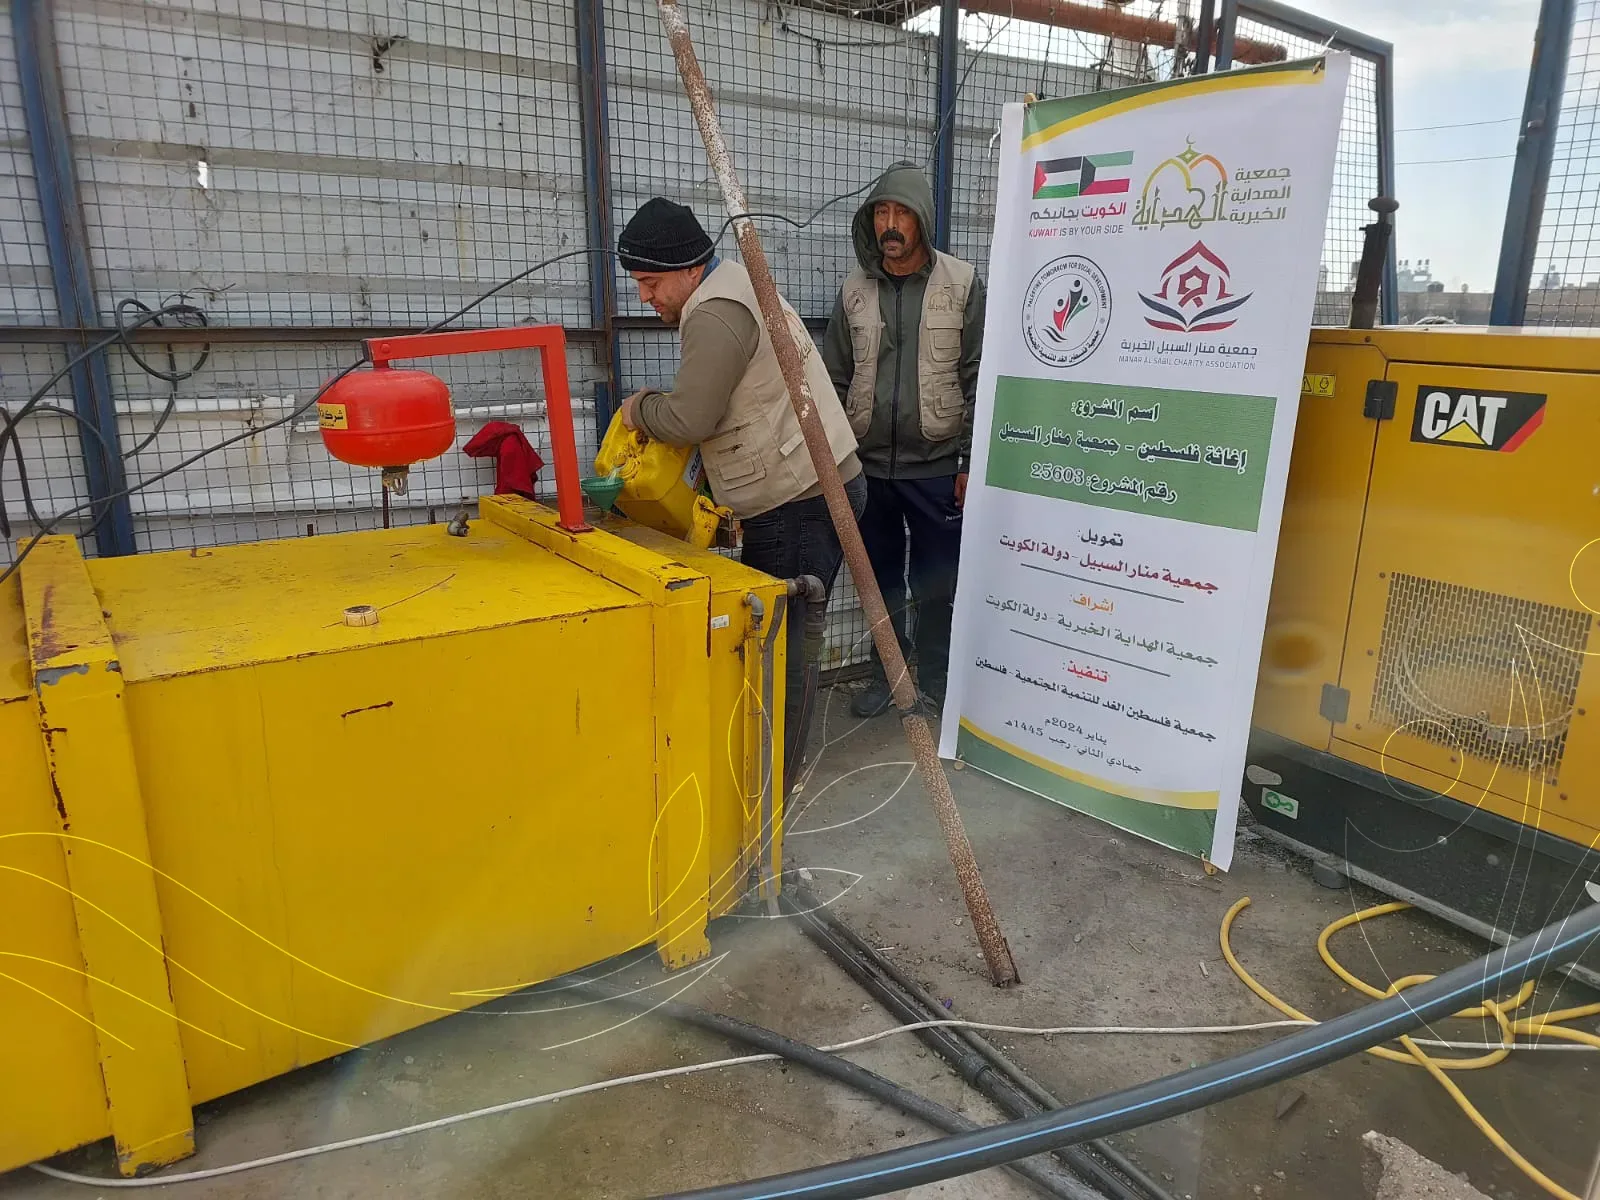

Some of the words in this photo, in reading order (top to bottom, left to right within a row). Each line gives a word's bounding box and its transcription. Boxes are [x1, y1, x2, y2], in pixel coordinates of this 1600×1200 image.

[1235, 167, 1291, 183] جمعية
[1231, 185, 1291, 204] الهداية
[1030, 206, 1079, 223] بجانبكم
[1081, 202, 1127, 219] الكويت
[1229, 206, 1287, 224] الخيرية
[1029, 228, 1058, 237] KUWAIT
[1060, 228, 1067, 236] IS
[1069, 227, 1079, 236] BY
[1080, 225, 1102, 235] YOUR
[1104, 224, 1124, 234] SIDE
[1121, 339, 1155, 352] الخيرية
[1157, 340, 1191, 354] السبيل
[1194, 342, 1215, 356] منار
[1219, 343, 1257, 359] جمعية
[1119, 355, 1142, 363] MANAR
[1153, 357, 1173, 365] SABIL
[1173, 358, 1203, 367] CHARITY
[1205, 360, 1256, 370] ASSOCIATION
[1127, 402, 1160, 424] اسم
[1421, 392, 1508, 445] CAT
[999, 423, 1042, 443] السبيل
[1042, 427, 1072, 447] منار
[1075, 431, 1120, 456] جمعية
[1137, 441, 1200, 463] فلسطين
[1204, 446, 1248, 473] إغاثة
[1031, 462, 1085, 485] 25603
[1143, 482, 1177, 504] رقم
[1000, 535, 1040, 553] الكويت
[1041, 542, 1070, 561] دولة
[1079, 553, 1128, 573] السبيل
[1128, 564, 1159, 581] منار
[1162, 567, 1218, 594] جمعية
[985, 595, 1021, 613] الكويت
[1022, 604, 1048, 622] دولة
[1057, 613, 1110, 638] الخيرية
[1114, 628, 1164, 652] الهداية
[1166, 642, 1218, 667] جمعية
[976, 656, 1007, 675] فلسطين
[1015, 669, 1060, 692] المجتمعية
[1061, 685, 1100, 705] للتنمية
[1102, 697, 1125, 713] الغد
[1126, 706, 1171, 728] فلسطين
[1084, 729, 1107, 745] يناير
[1174, 718, 1217, 742] جمعية
[1048, 735, 1071, 750] رجب
[1106, 756, 1142, 773] جمادي
